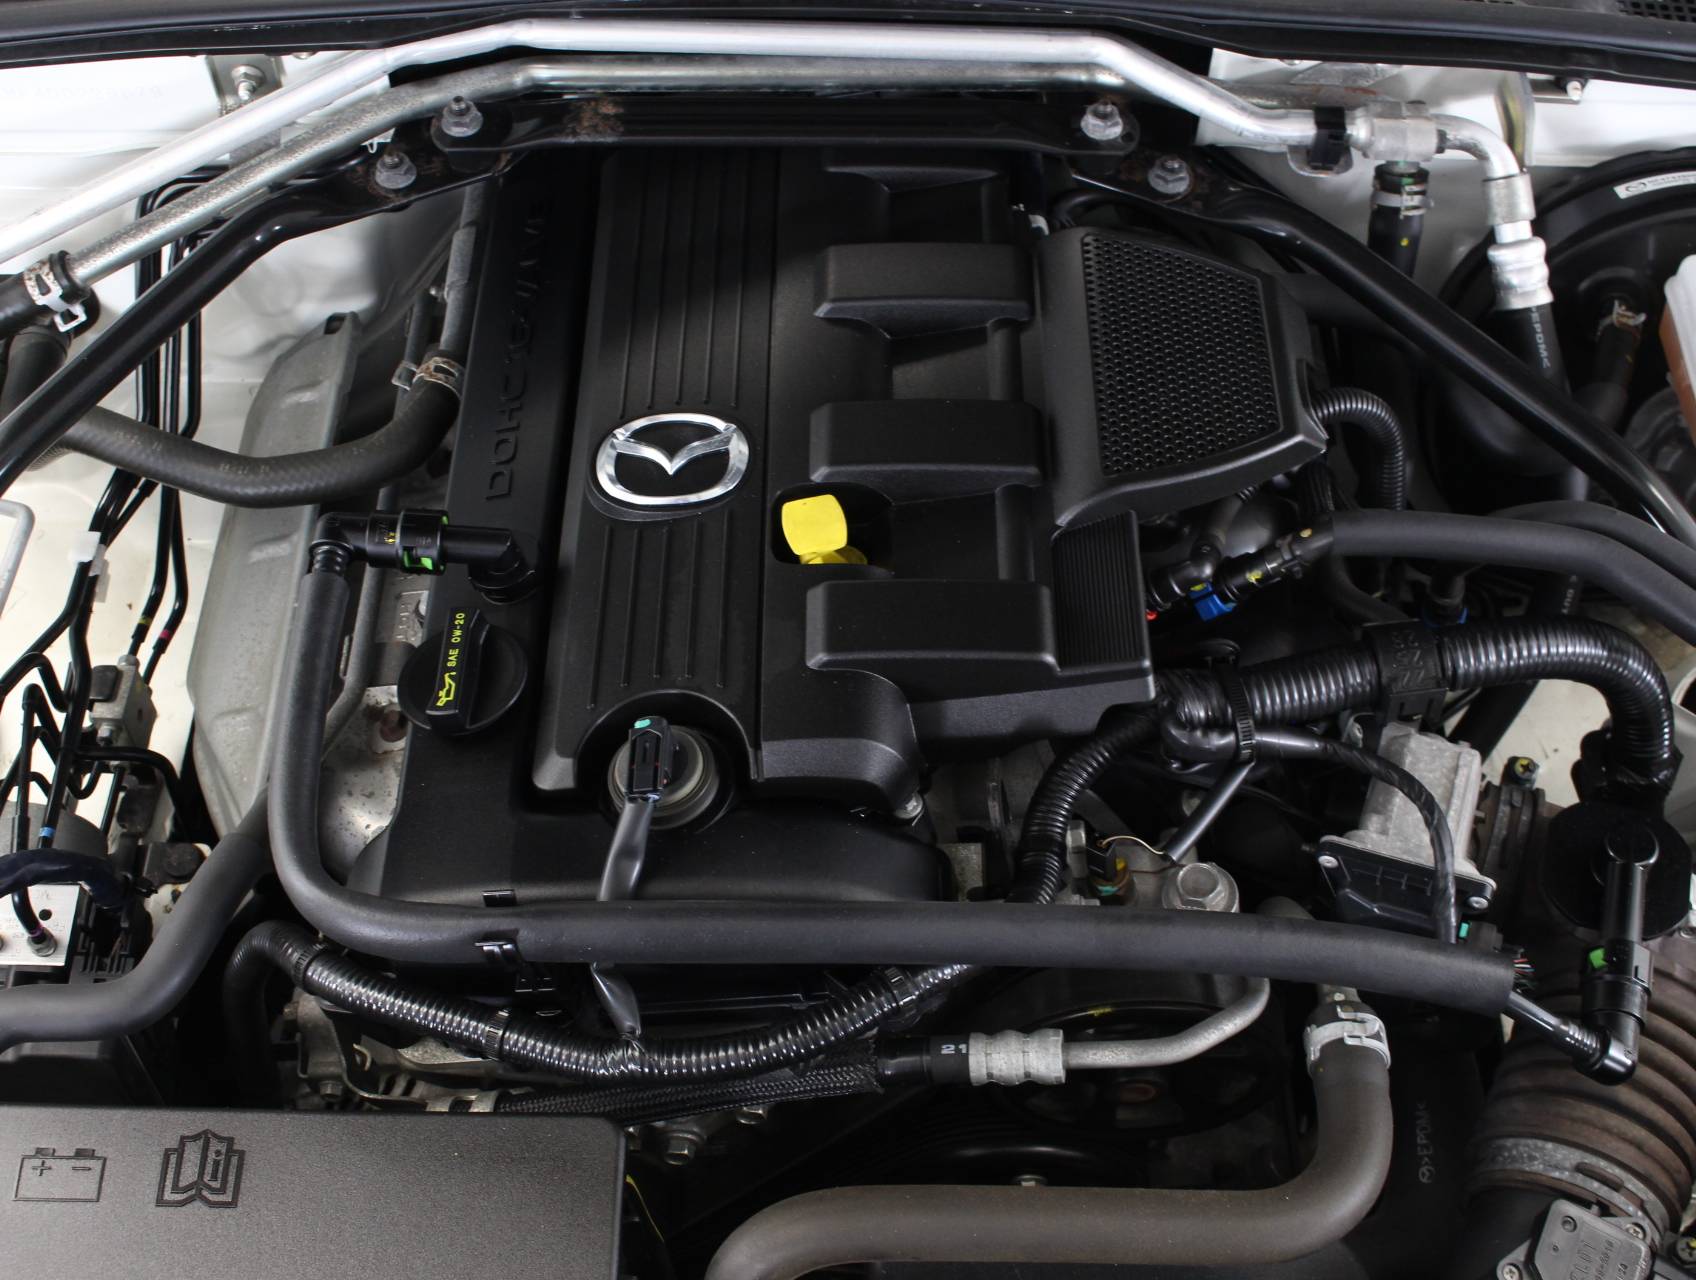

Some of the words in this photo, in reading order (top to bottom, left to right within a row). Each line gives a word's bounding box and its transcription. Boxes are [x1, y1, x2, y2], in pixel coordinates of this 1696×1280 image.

[486, 367, 527, 501] DOHC
[450, 612, 466, 643] 0W-20
[446, 648, 460, 667] SAE
[941, 1044, 967, 1054] 21
